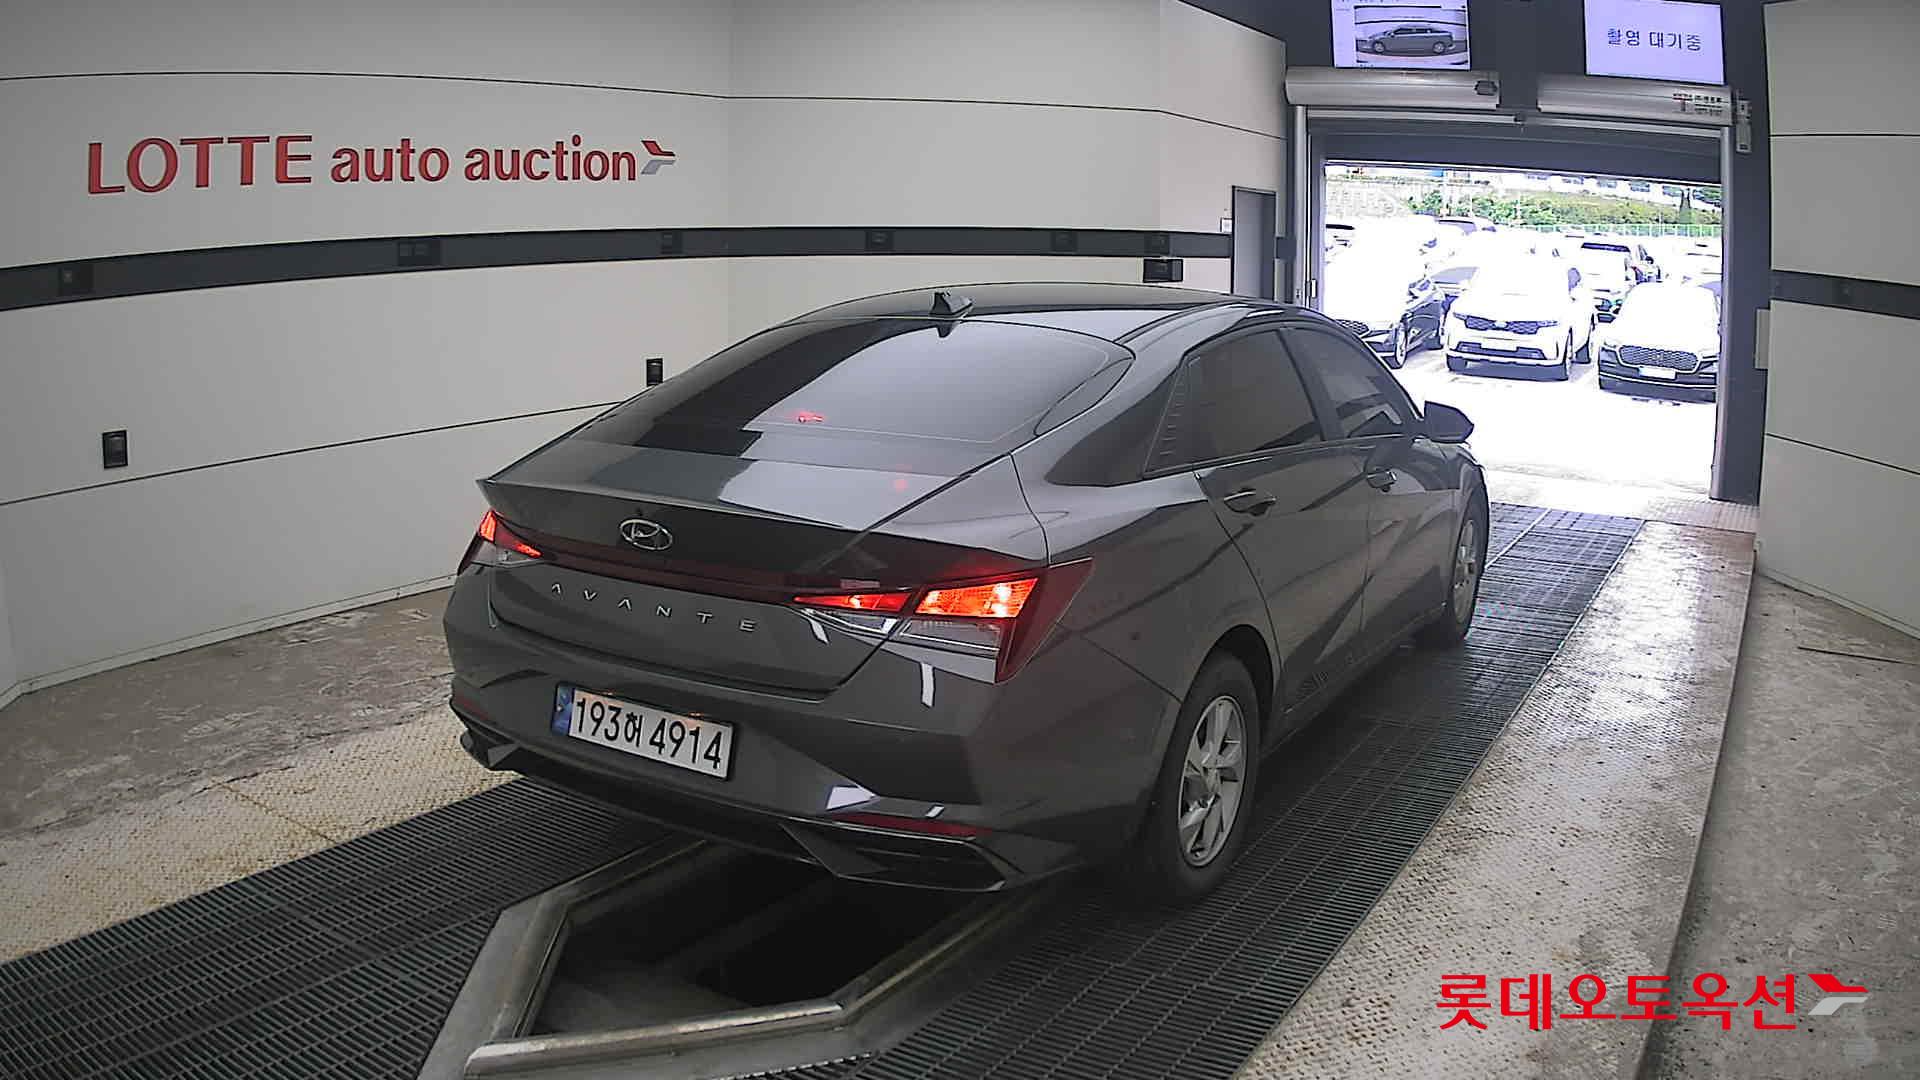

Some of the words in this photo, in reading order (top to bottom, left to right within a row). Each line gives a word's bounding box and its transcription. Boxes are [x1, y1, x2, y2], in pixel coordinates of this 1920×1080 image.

[1648, 31, 1702, 52] 대기중
[87, 134, 313, 195] LOTTE
[330, 137, 450, 183] auto
[463, 133, 637, 182] auction
[551, 582, 756, 632] AVANTE
[576, 697, 643, 748] 193허
[649, 717, 723, 770] 4914
